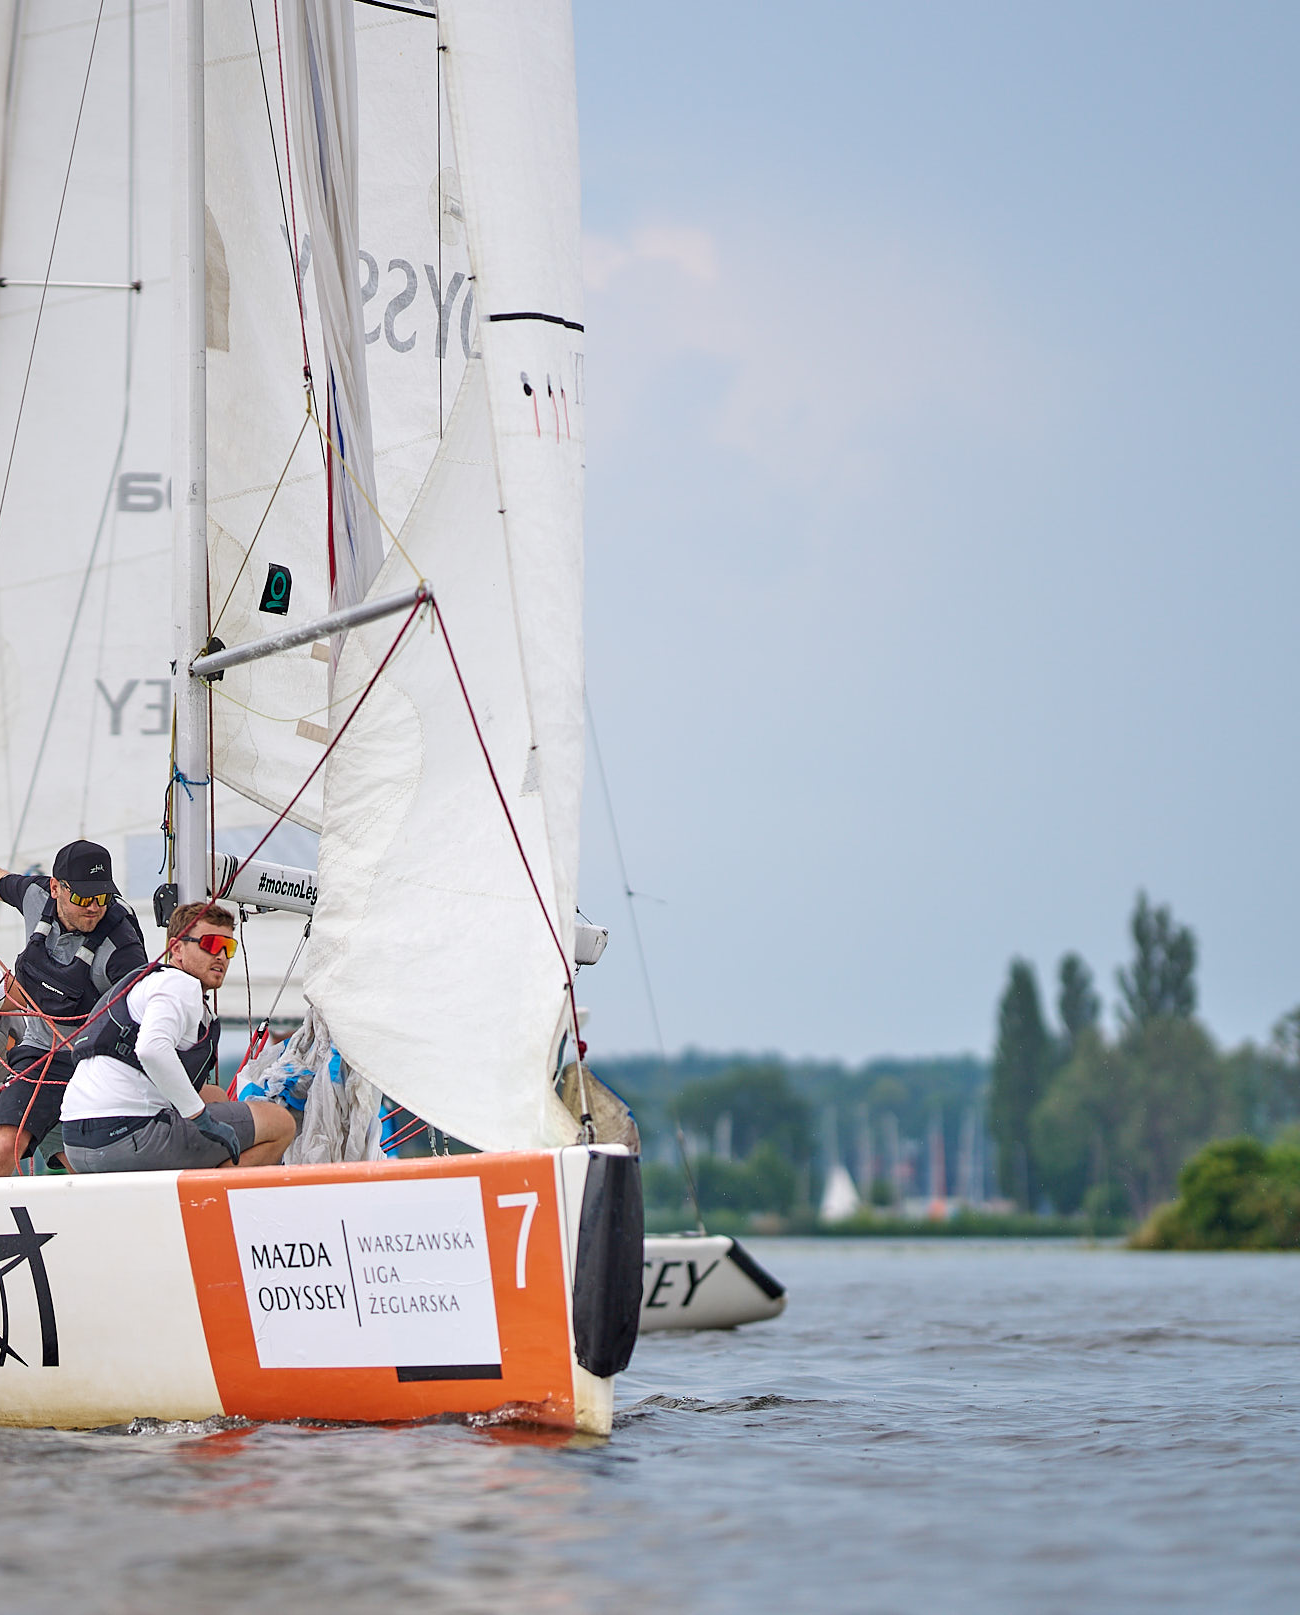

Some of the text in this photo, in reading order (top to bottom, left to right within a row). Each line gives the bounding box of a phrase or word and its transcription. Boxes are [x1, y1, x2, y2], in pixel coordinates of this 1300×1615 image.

[257, 872, 318, 906] #mocnoLeg
[356, 1231, 476, 1253] WARSZAWSKA
[497, 1191, 539, 1289] 7
[251, 1241, 332, 1270] MAZDA
[363, 1265, 401, 1285] LIGA
[643, 1258, 720, 1309] EY
[258, 1284, 347, 1313] ODYSSEY
[369, 1292, 461, 1315] ŻEGLARSKA
